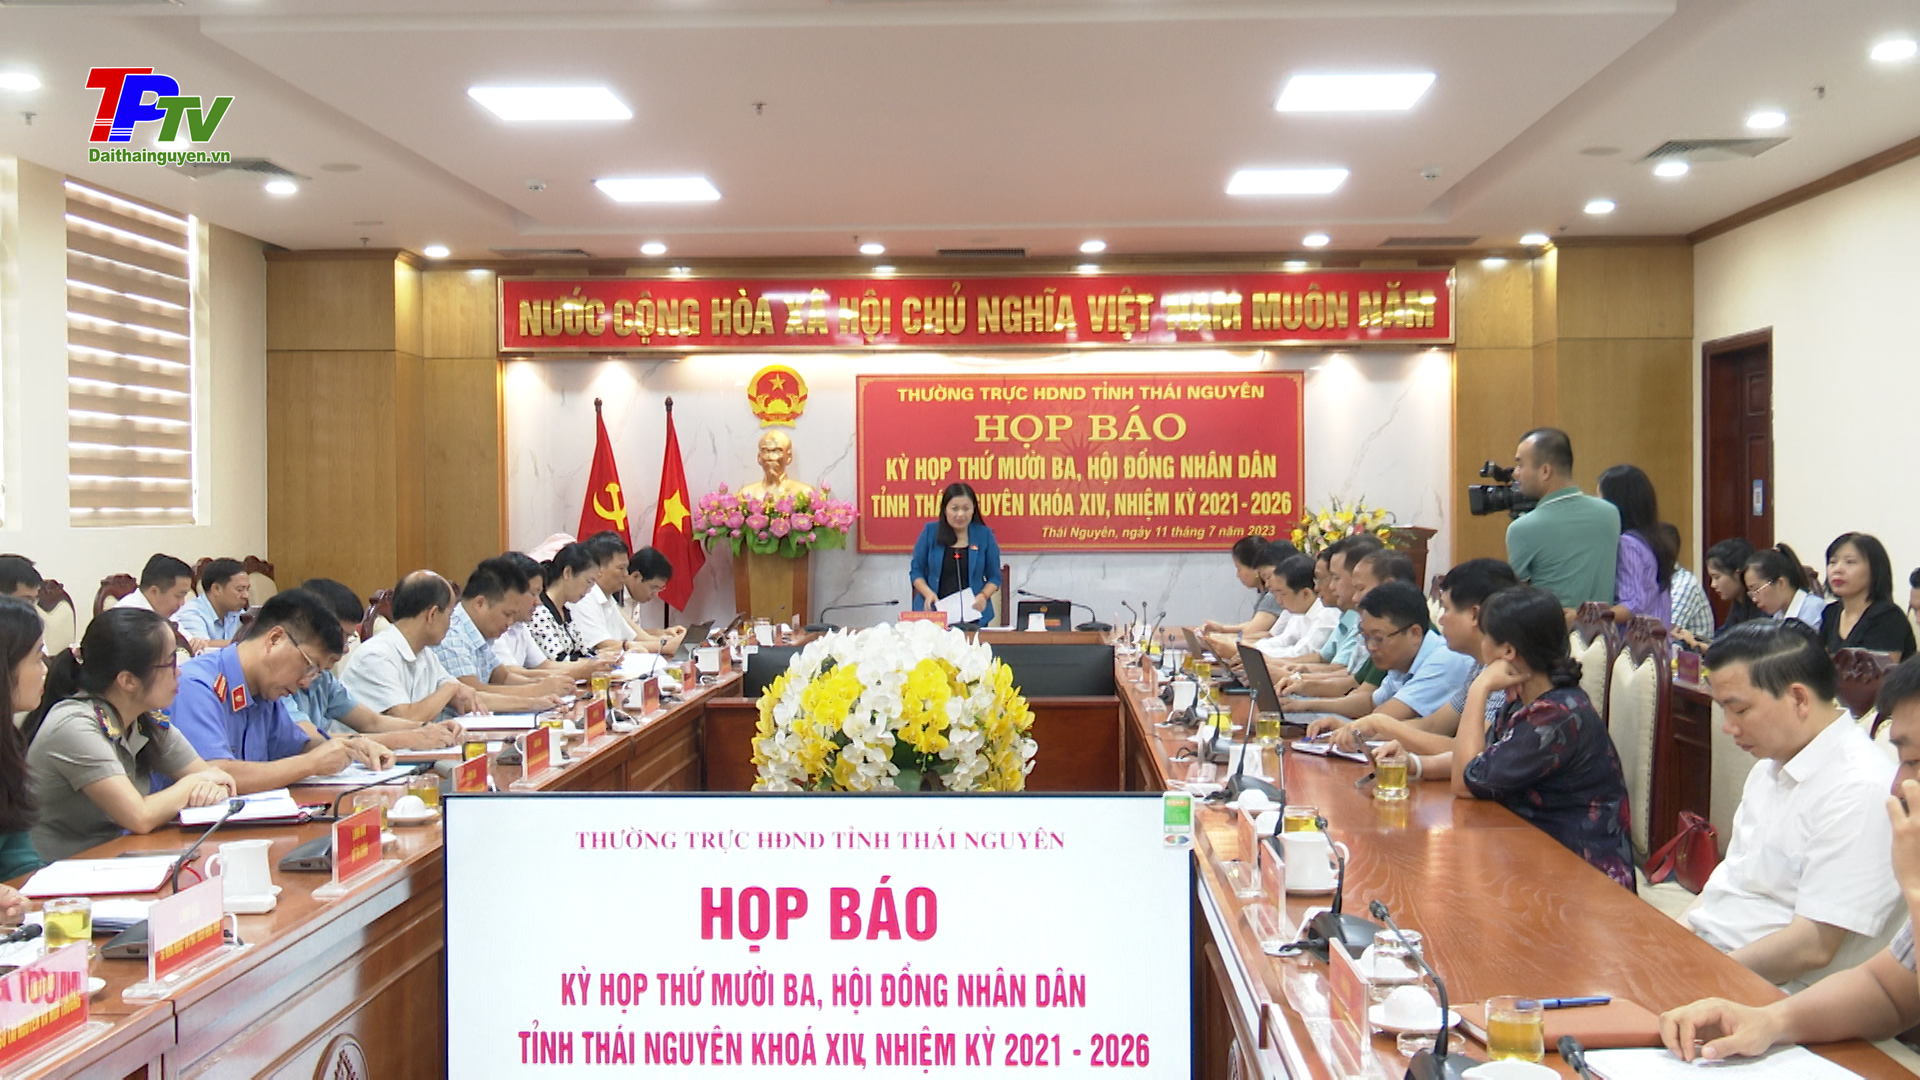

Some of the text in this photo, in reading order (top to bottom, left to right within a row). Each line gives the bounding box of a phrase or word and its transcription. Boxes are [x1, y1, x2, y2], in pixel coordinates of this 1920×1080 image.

[519, 281, 1437, 345] NƯỚC CỘNG HÒA XÃ HỘI CHỦ NGHĨA VIỆT NAM MUÔN NĂM
[897, 383, 974, 402] THƯỜNG
[979, 386, 1028, 404] TRỰC
[1091, 381, 1134, 400] TỈNH
[1139, 382, 1181, 399] THÁI
[1187, 382, 1265, 398] NGUYÊN
[974, 405, 1187, 449] HỌP BÁO
[886, 452, 909, 480] KỲ
[915, 457, 952, 485] HỌP
[957, 450, 994, 480] THỨ
[998, 450, 1046, 480] MƯỜI
[1052, 457, 1081, 482] BA,
[1087, 451, 1118, 484] HỘI
[1180, 449, 1232, 479] NHÂN
[1238, 449, 1276, 478] DÂN
[871, 486, 909, 517] TỈNH
[914, 489, 943, 517] THÁ
[976, 488, 1024, 516] UYÊN
[1029, 488, 1074, 516] KHÓA
[1079, 493, 1110, 519] XIV,
[1114, 488, 1169, 520] NHIỆM
[1175, 488, 1196, 516] KỲ
[1200, 491, 1238, 516] 2021
[1250, 491, 1292, 515] 2026
[1042, 525, 1276, 540] Thái Nguyên, ngày 11 tháng 7 năm 2023
[576, 826, 1065, 853] THƯỜNG TRỰC HĐND TỈNH THÁI NGUYÊN
[700, 875, 938, 953] HỌP BÁO
[561, 961, 1086, 1015] KỲ HỌP THỨ MƯỜI BA, HỘI ĐỒNG NHÂN DÂN
[518, 1018, 573, 1064] TỈNH
[581, 1023, 635, 1065] THÁI
[644, 1024, 743, 1066] NGUYÊN
[751, 1025, 817, 1066] KHOÁ
[825, 1032, 867, 1069] XIV,
[875, 1024, 956, 1074] NHIỆM
[965, 1024, 996, 1066] KỲ
[1004, 1032, 1060, 1067] 2021
[1090, 1032, 1150, 1068] 2026
